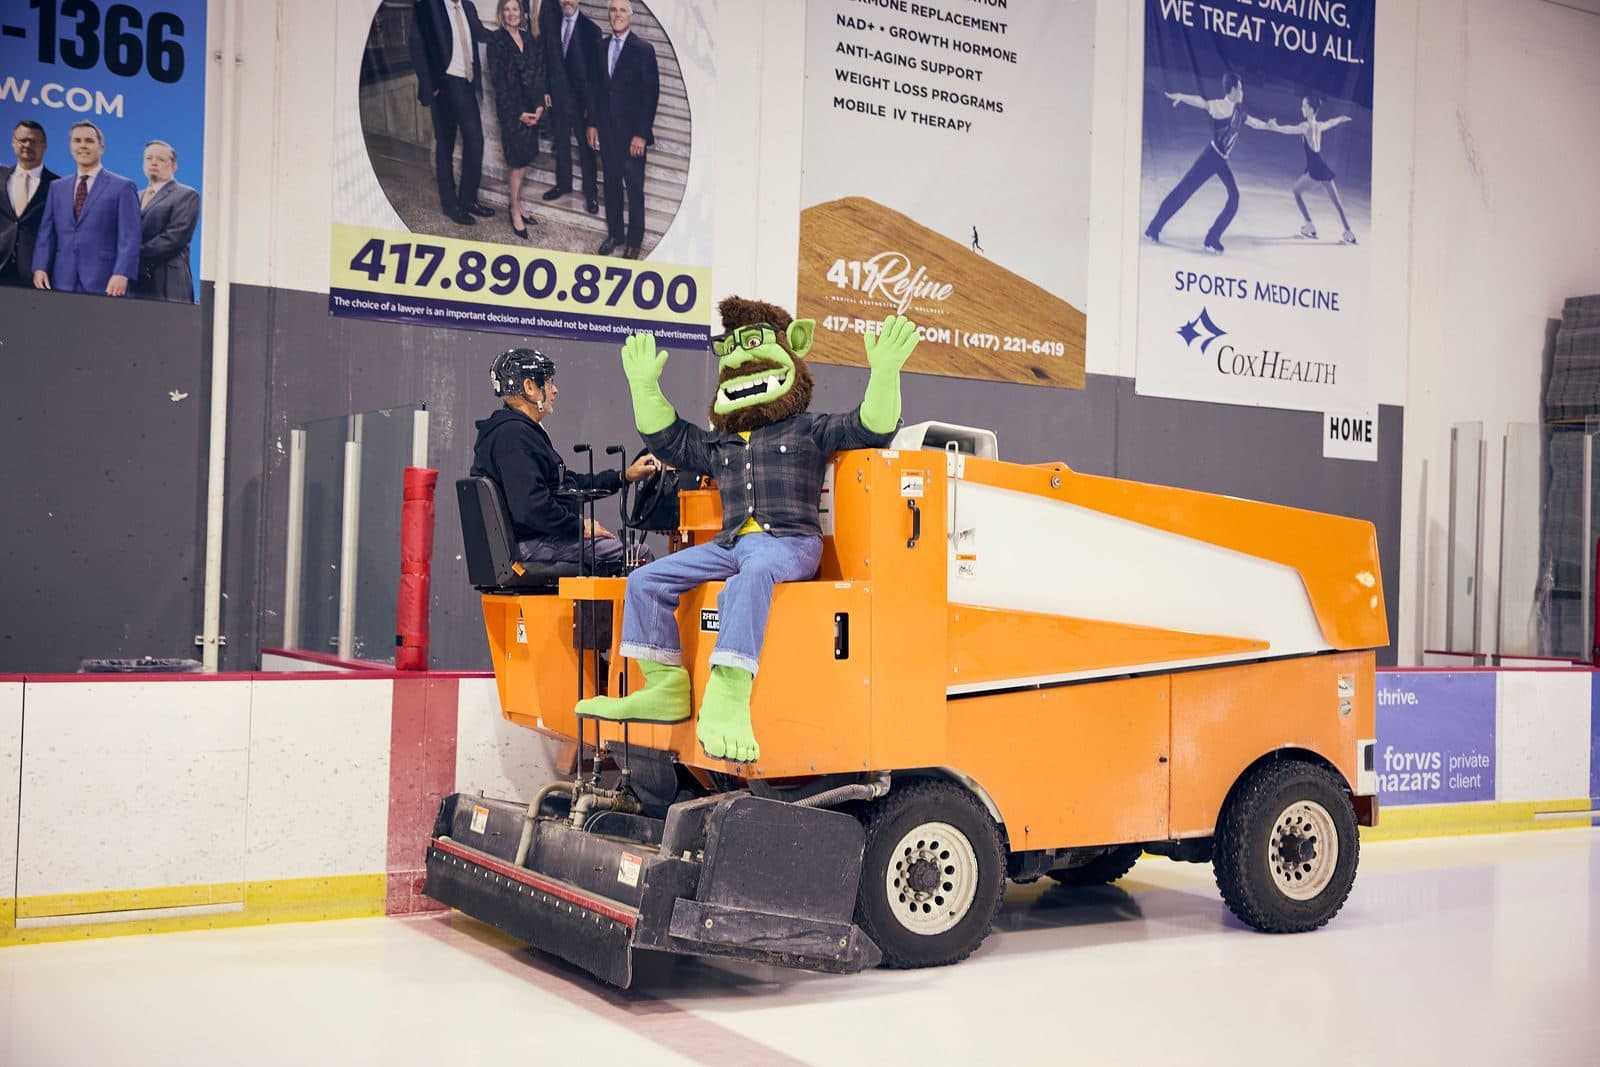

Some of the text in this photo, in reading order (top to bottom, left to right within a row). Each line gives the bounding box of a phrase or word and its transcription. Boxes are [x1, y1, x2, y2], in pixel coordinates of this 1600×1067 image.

[911, 4, 1008, 34] REPLACEMENT
[1160, 0, 1365, 64] WE TREAT YOU ALL.
[836, 14, 1017, 64] NAD+ GROWTH HORMONE
[836, 42, 983, 82] ANTI-AGING SUPPORT
[835, 68, 1004, 113] WEIGHT LOSS PROGRAMS
[833, 96, 972, 133] MOBILE IV THERAPY
[350, 238, 698, 313] 417.890.8700
[1175, 271, 1340, 311] SPORTS MEDICINE
[334, 296, 350, 307] The
[351, 298, 379, 310] choice
[380, 301, 390, 311] of
[397, 304, 425, 316] lawyer
[426, 306, 432, 315] is
[434, 309, 444, 317] an
[446, 308, 486, 320] important
[487, 313, 519, 324] decision
[521, 316, 535, 326] and
[537, 317, 562, 328] should
[564, 320, 576, 329] not
[578, 321, 588, 330] be
[589, 322, 611, 332] based
[613, 324, 633, 335] solely
[655, 329, 708, 341] advertisements
[963, 332, 1000, 351] (417)
[1003, 336, 1065, 357] 221-6419
[1330, 417, 1372, 443] HOME
[1377, 688, 1418, 705] thrive.
[1449, 752, 1490, 772] private
[1448, 773, 1481, 790] client
